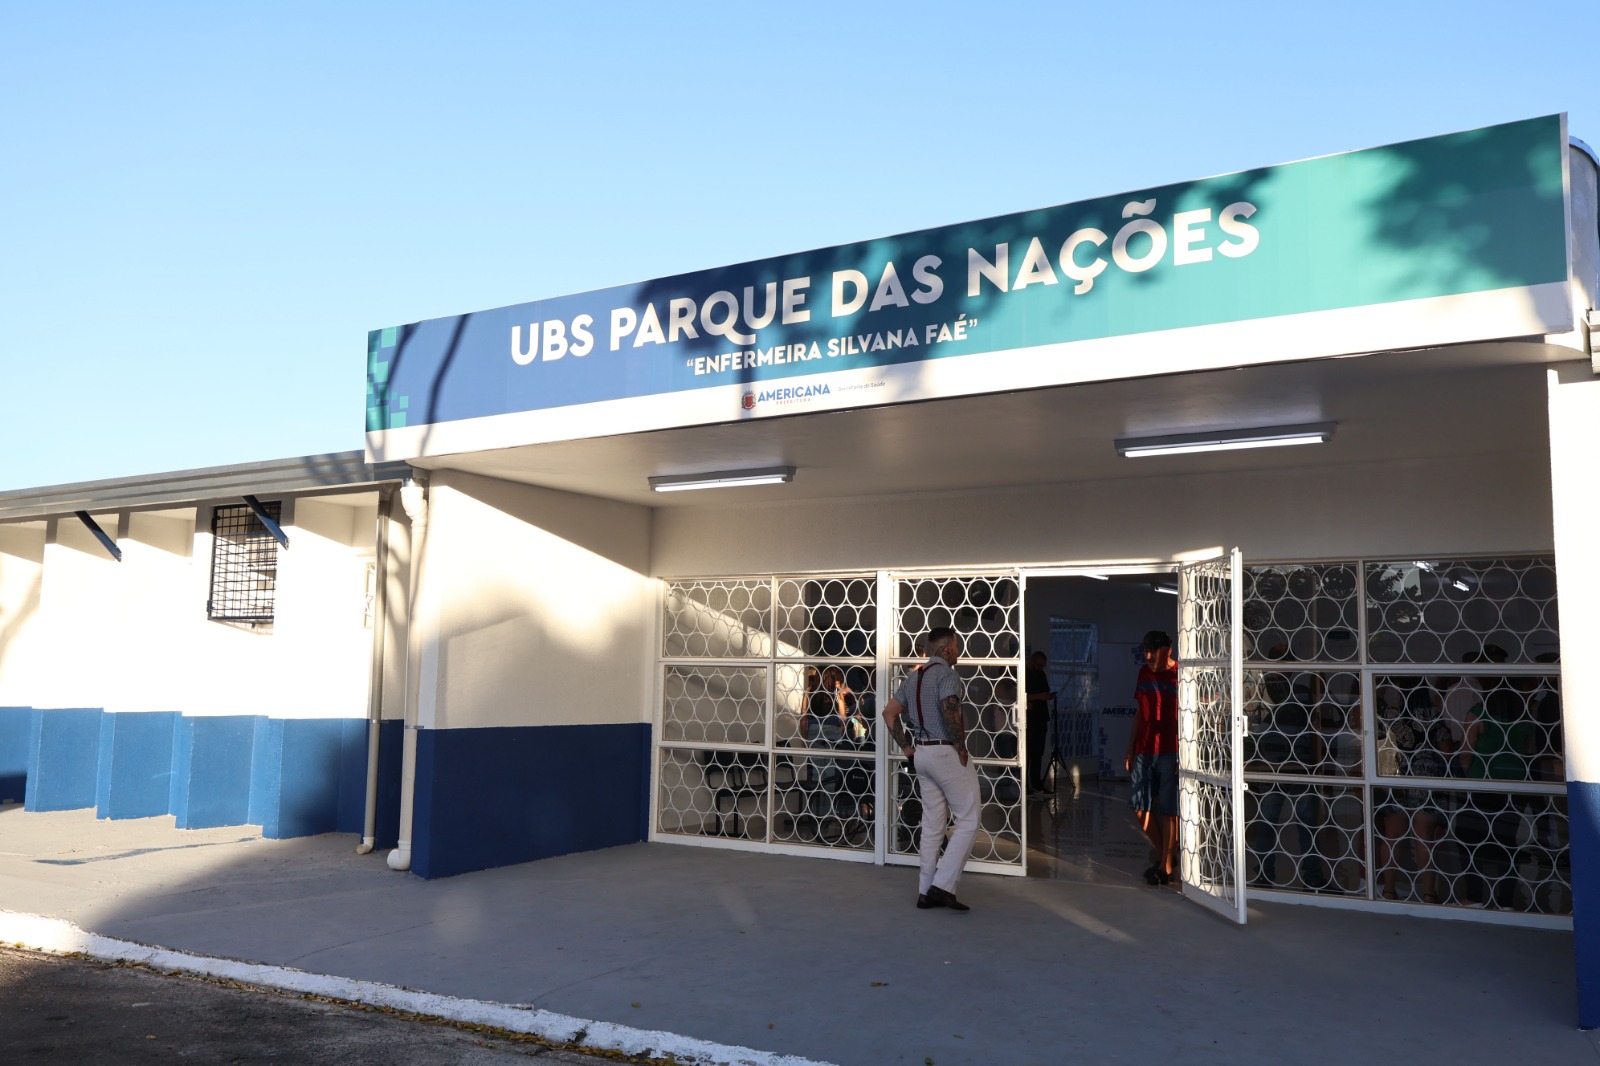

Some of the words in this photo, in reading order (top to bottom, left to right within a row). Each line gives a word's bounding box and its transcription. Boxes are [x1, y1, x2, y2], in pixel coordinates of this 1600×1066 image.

[511, 314, 594, 366] UBS
[609, 276, 811, 352] PARQUE
[830, 254, 944, 317] DAS
[967, 198, 1260, 296] NAÇÕES
[686, 340, 822, 376] “ENFERMEIRA
[827, 327, 919, 358] SILVANA
[925, 314, 979, 345] FAÉ”
[758, 384, 831, 402] AMERICANA
[776, 397, 811, 405] PREFEITURA
[1102, 707, 1137, 715] AMERICAN
